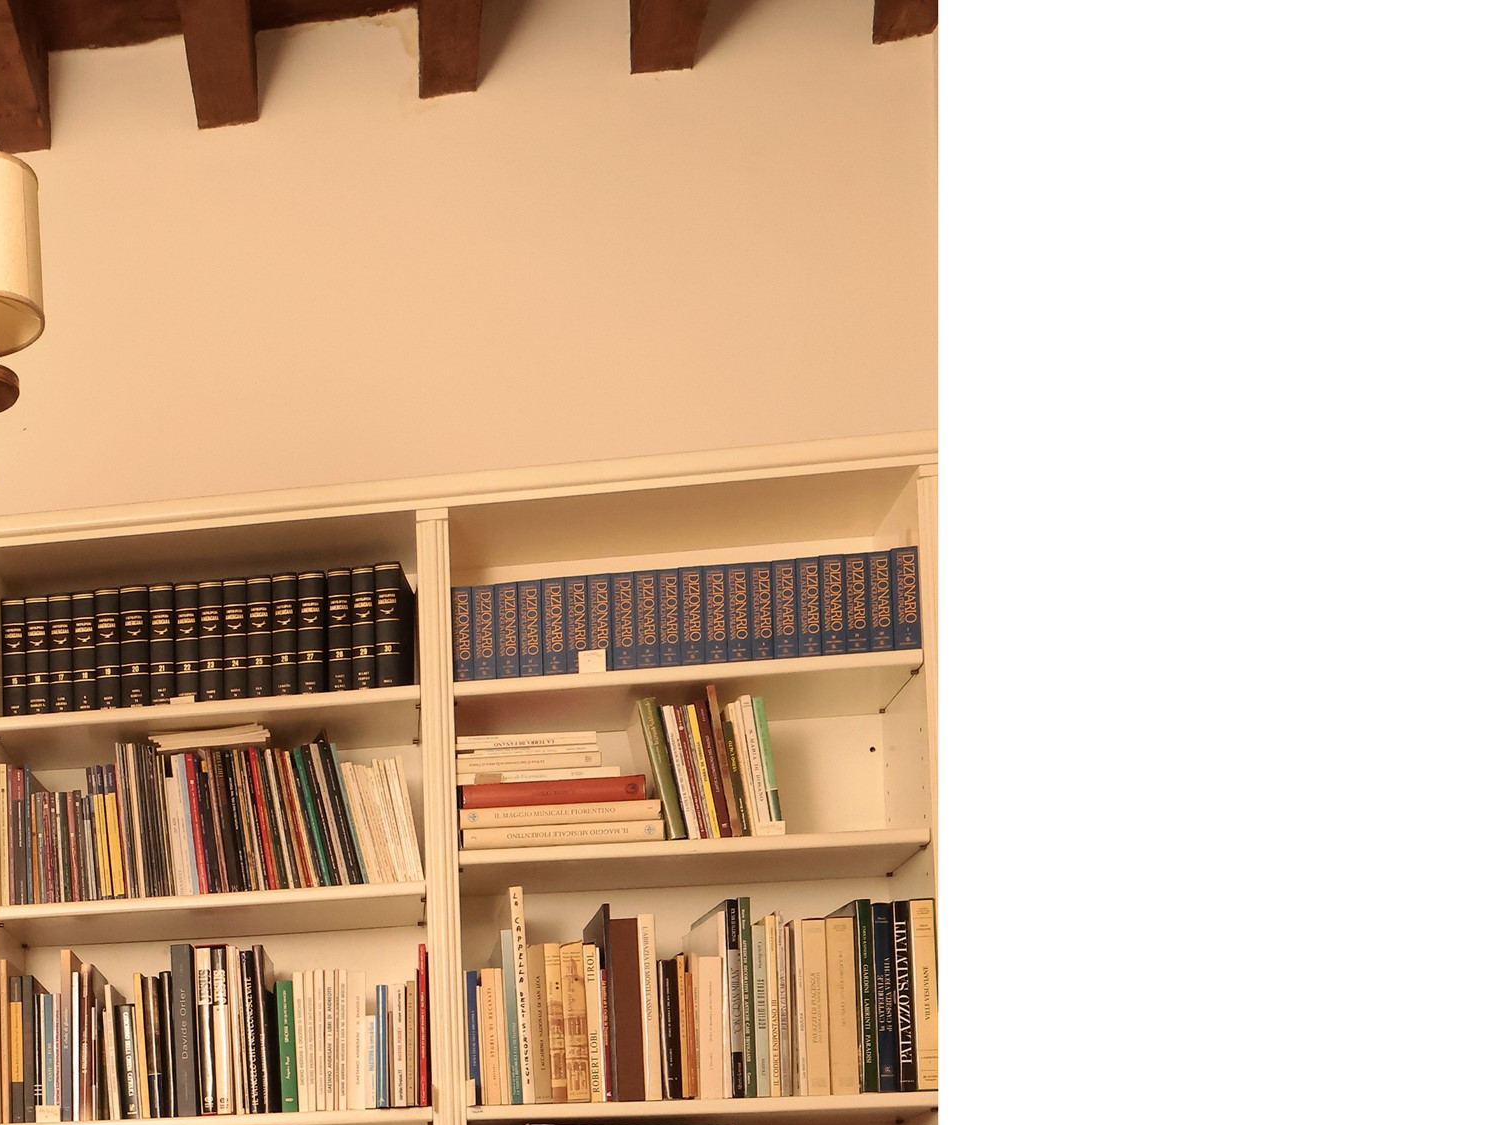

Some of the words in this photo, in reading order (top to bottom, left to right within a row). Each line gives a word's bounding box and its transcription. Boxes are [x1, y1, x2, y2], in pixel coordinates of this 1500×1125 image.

[550, 585, 564, 653] DIZIONARIO
[596, 581, 609, 649] DIZIONARIO
[642, 577, 656, 646] DIZIONARIO
[688, 574, 702, 642] DIZIONARIO
[734, 571, 748, 640] DIZIONARIO
[781, 567, 795, 636] DIZIONARIO
[829, 562, 843, 632] DIZIONARIO
[852, 560, 866, 630] DIZIONARIO
[876, 558, 891, 628] DIZIONARIO
[902, 553, 917, 624] DIZIONARIO
[457, 593, 470, 661] DIZIONARIO
[504, 589, 517, 657] DIZIONARIO
[506, 831, 551, 839] FIORENTINO
[535, 809, 569, 817] MUSICALE
[590, 828, 620, 836] MAGGIO
[198, 969, 212, 1003] JESUS
[213, 969, 228, 1004] JESUS
[587, 952, 595, 982] TIROL
[645, 962, 650, 970] DI
[895, 920, 910, 990] SALVIATI
[179, 988, 187, 1016] Orler
[885, 991, 893, 1024] CASERTA
[899, 995, 913, 1063] PALAZZO
[181, 1021, 189, 1059] Davide
[589, 1057, 599, 1093] ROBERT
